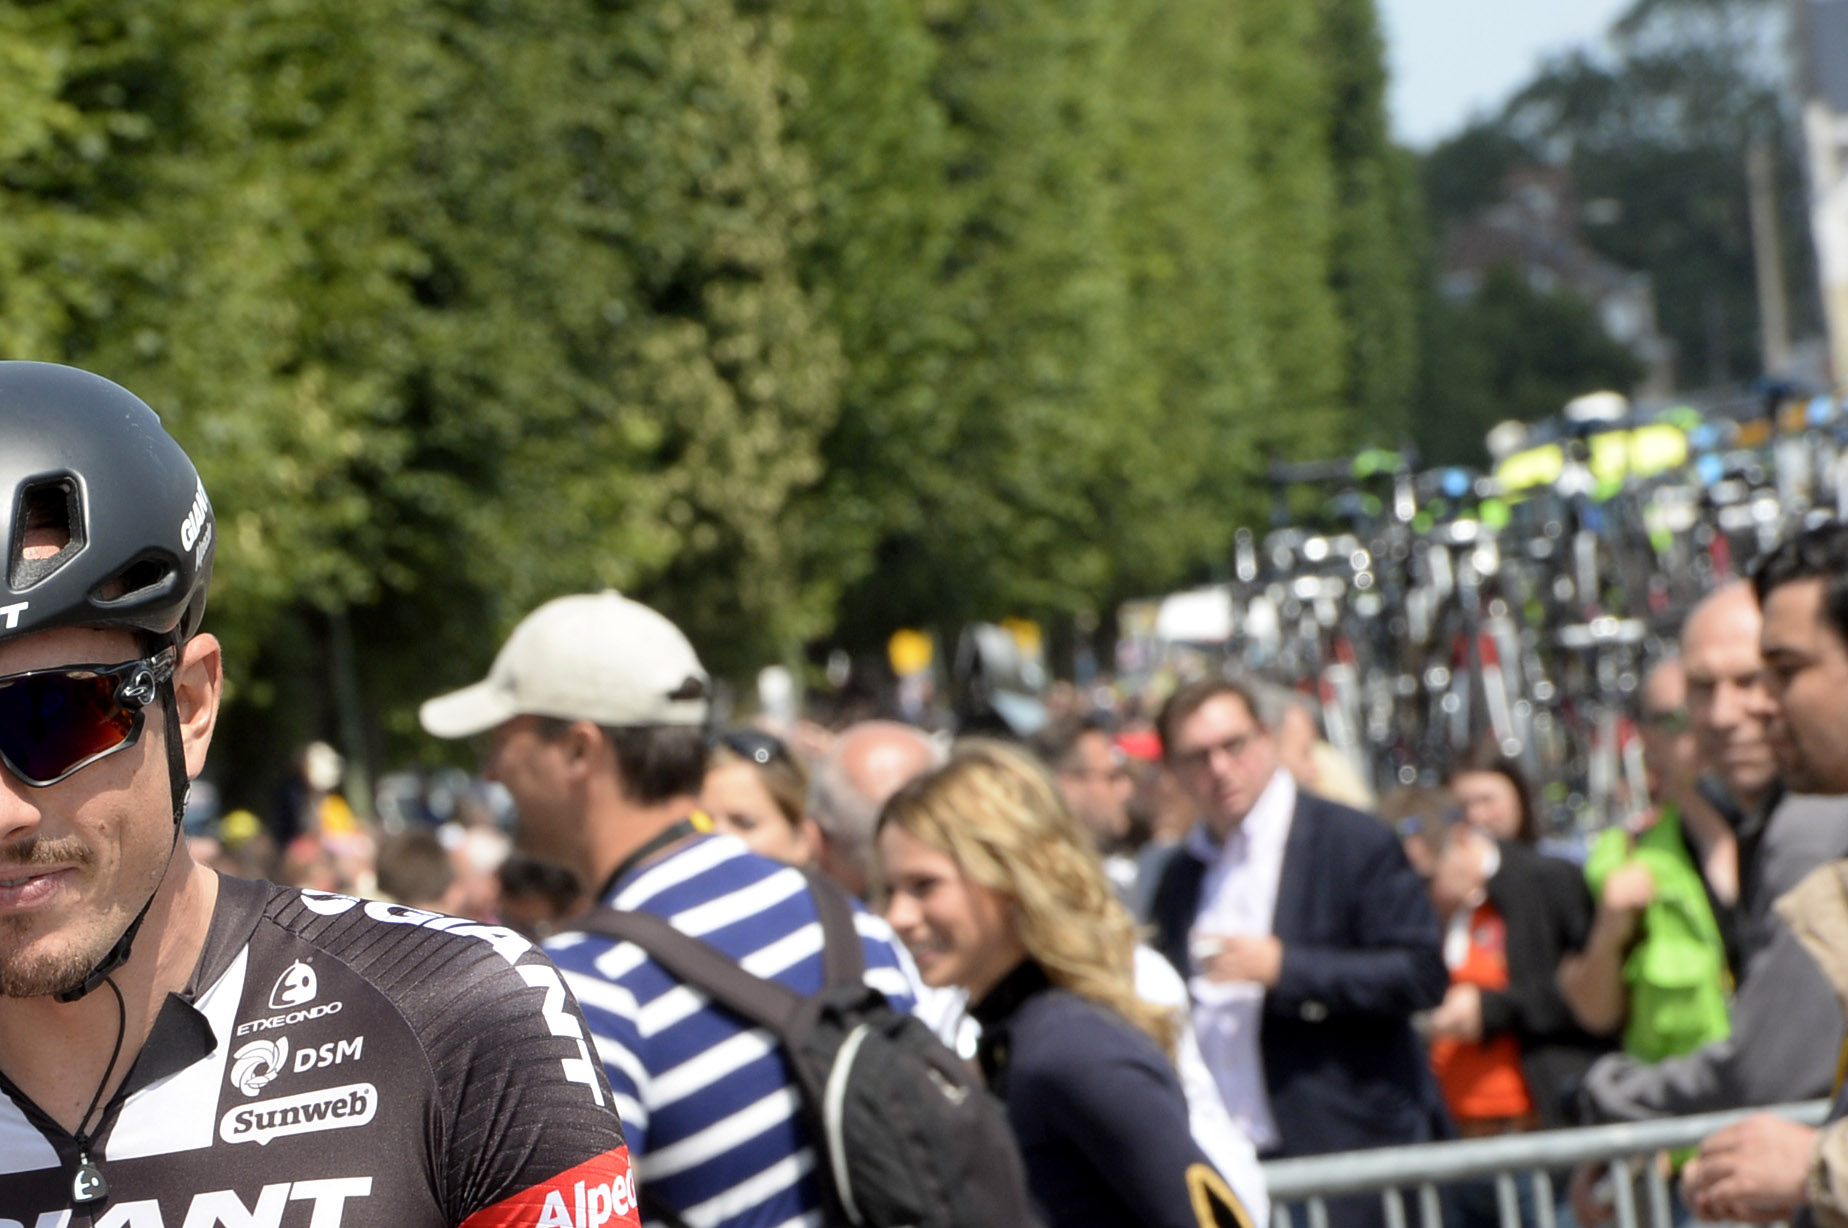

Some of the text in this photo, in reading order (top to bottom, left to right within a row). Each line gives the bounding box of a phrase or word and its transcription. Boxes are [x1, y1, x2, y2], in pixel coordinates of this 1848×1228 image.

[236, 1001, 343, 1037] ETXEONDO
[293, 1036, 364, 1073] DSM
[233, 1090, 368, 1134] Sunweb
